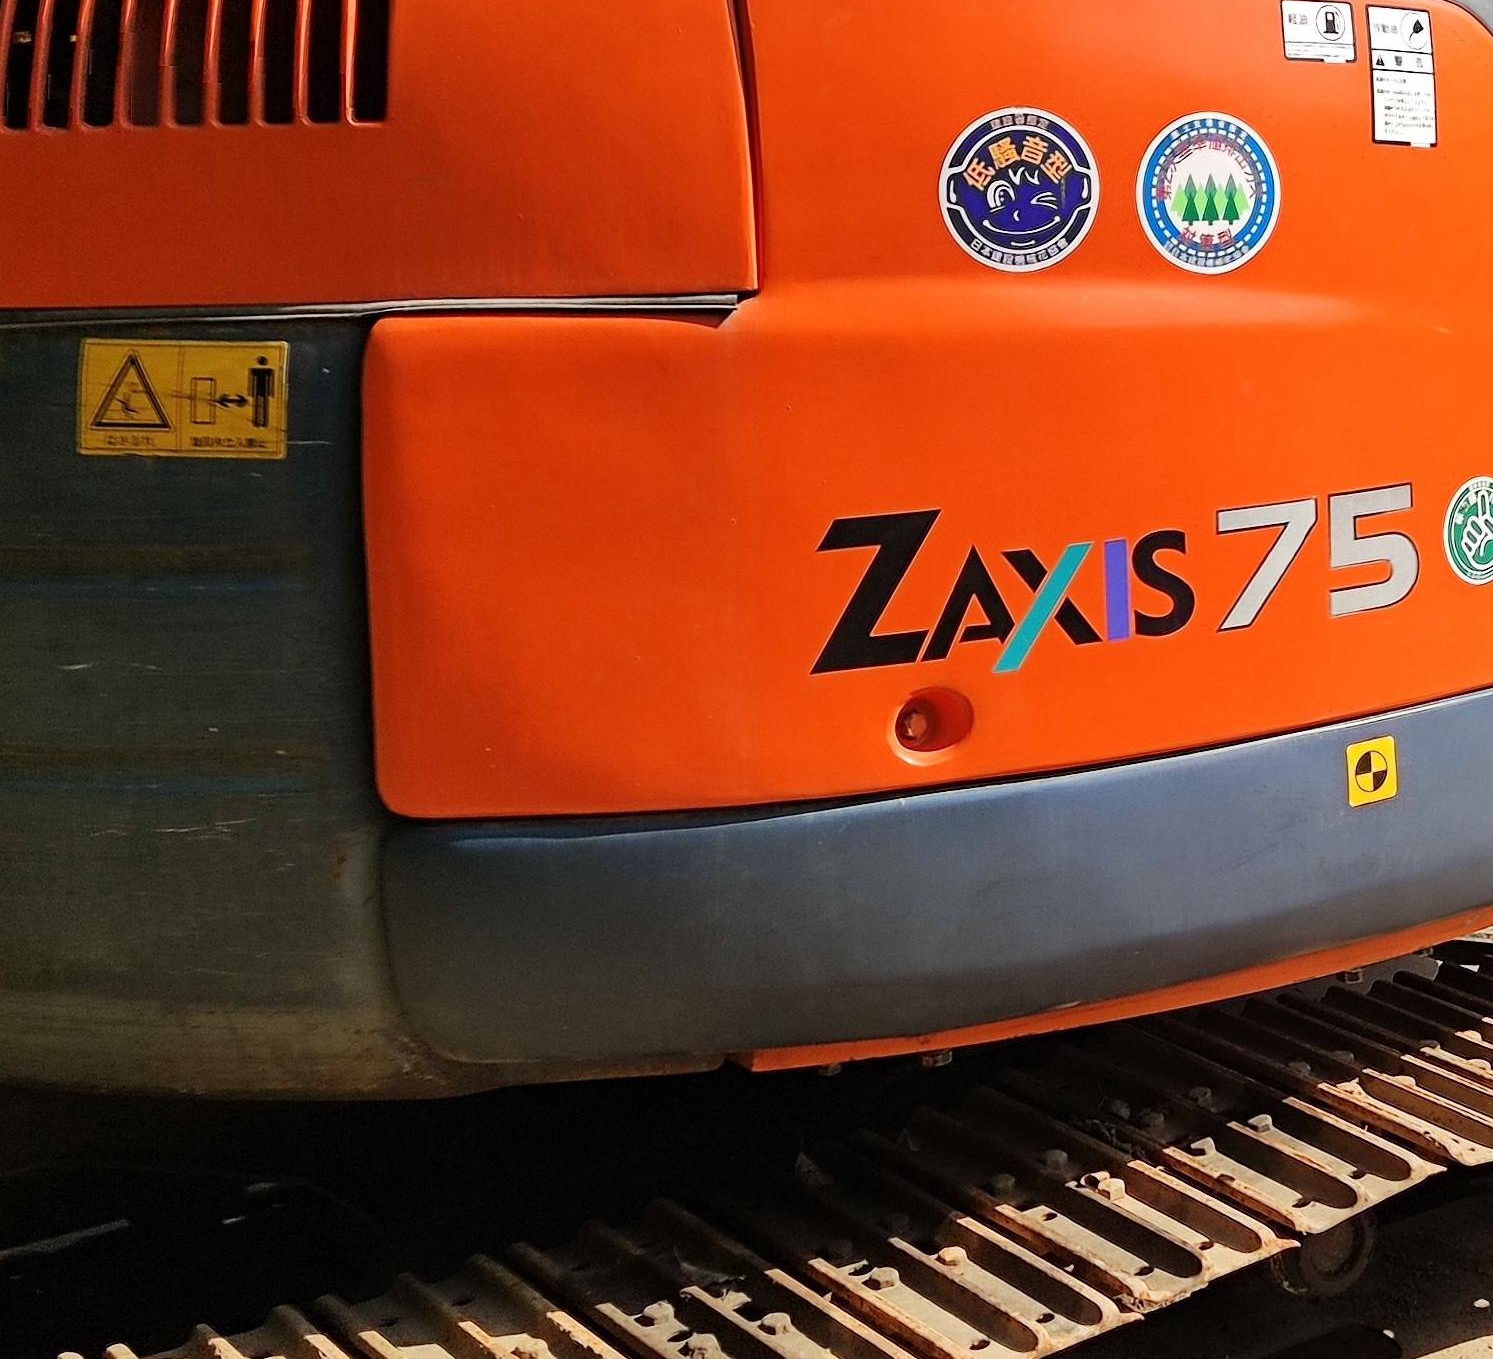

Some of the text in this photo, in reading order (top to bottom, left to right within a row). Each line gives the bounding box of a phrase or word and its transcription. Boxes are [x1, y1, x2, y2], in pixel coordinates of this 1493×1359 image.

[963, 135, 1073, 191] 低騒音型
[810, 483, 1421, 674] ZAXIS 75
